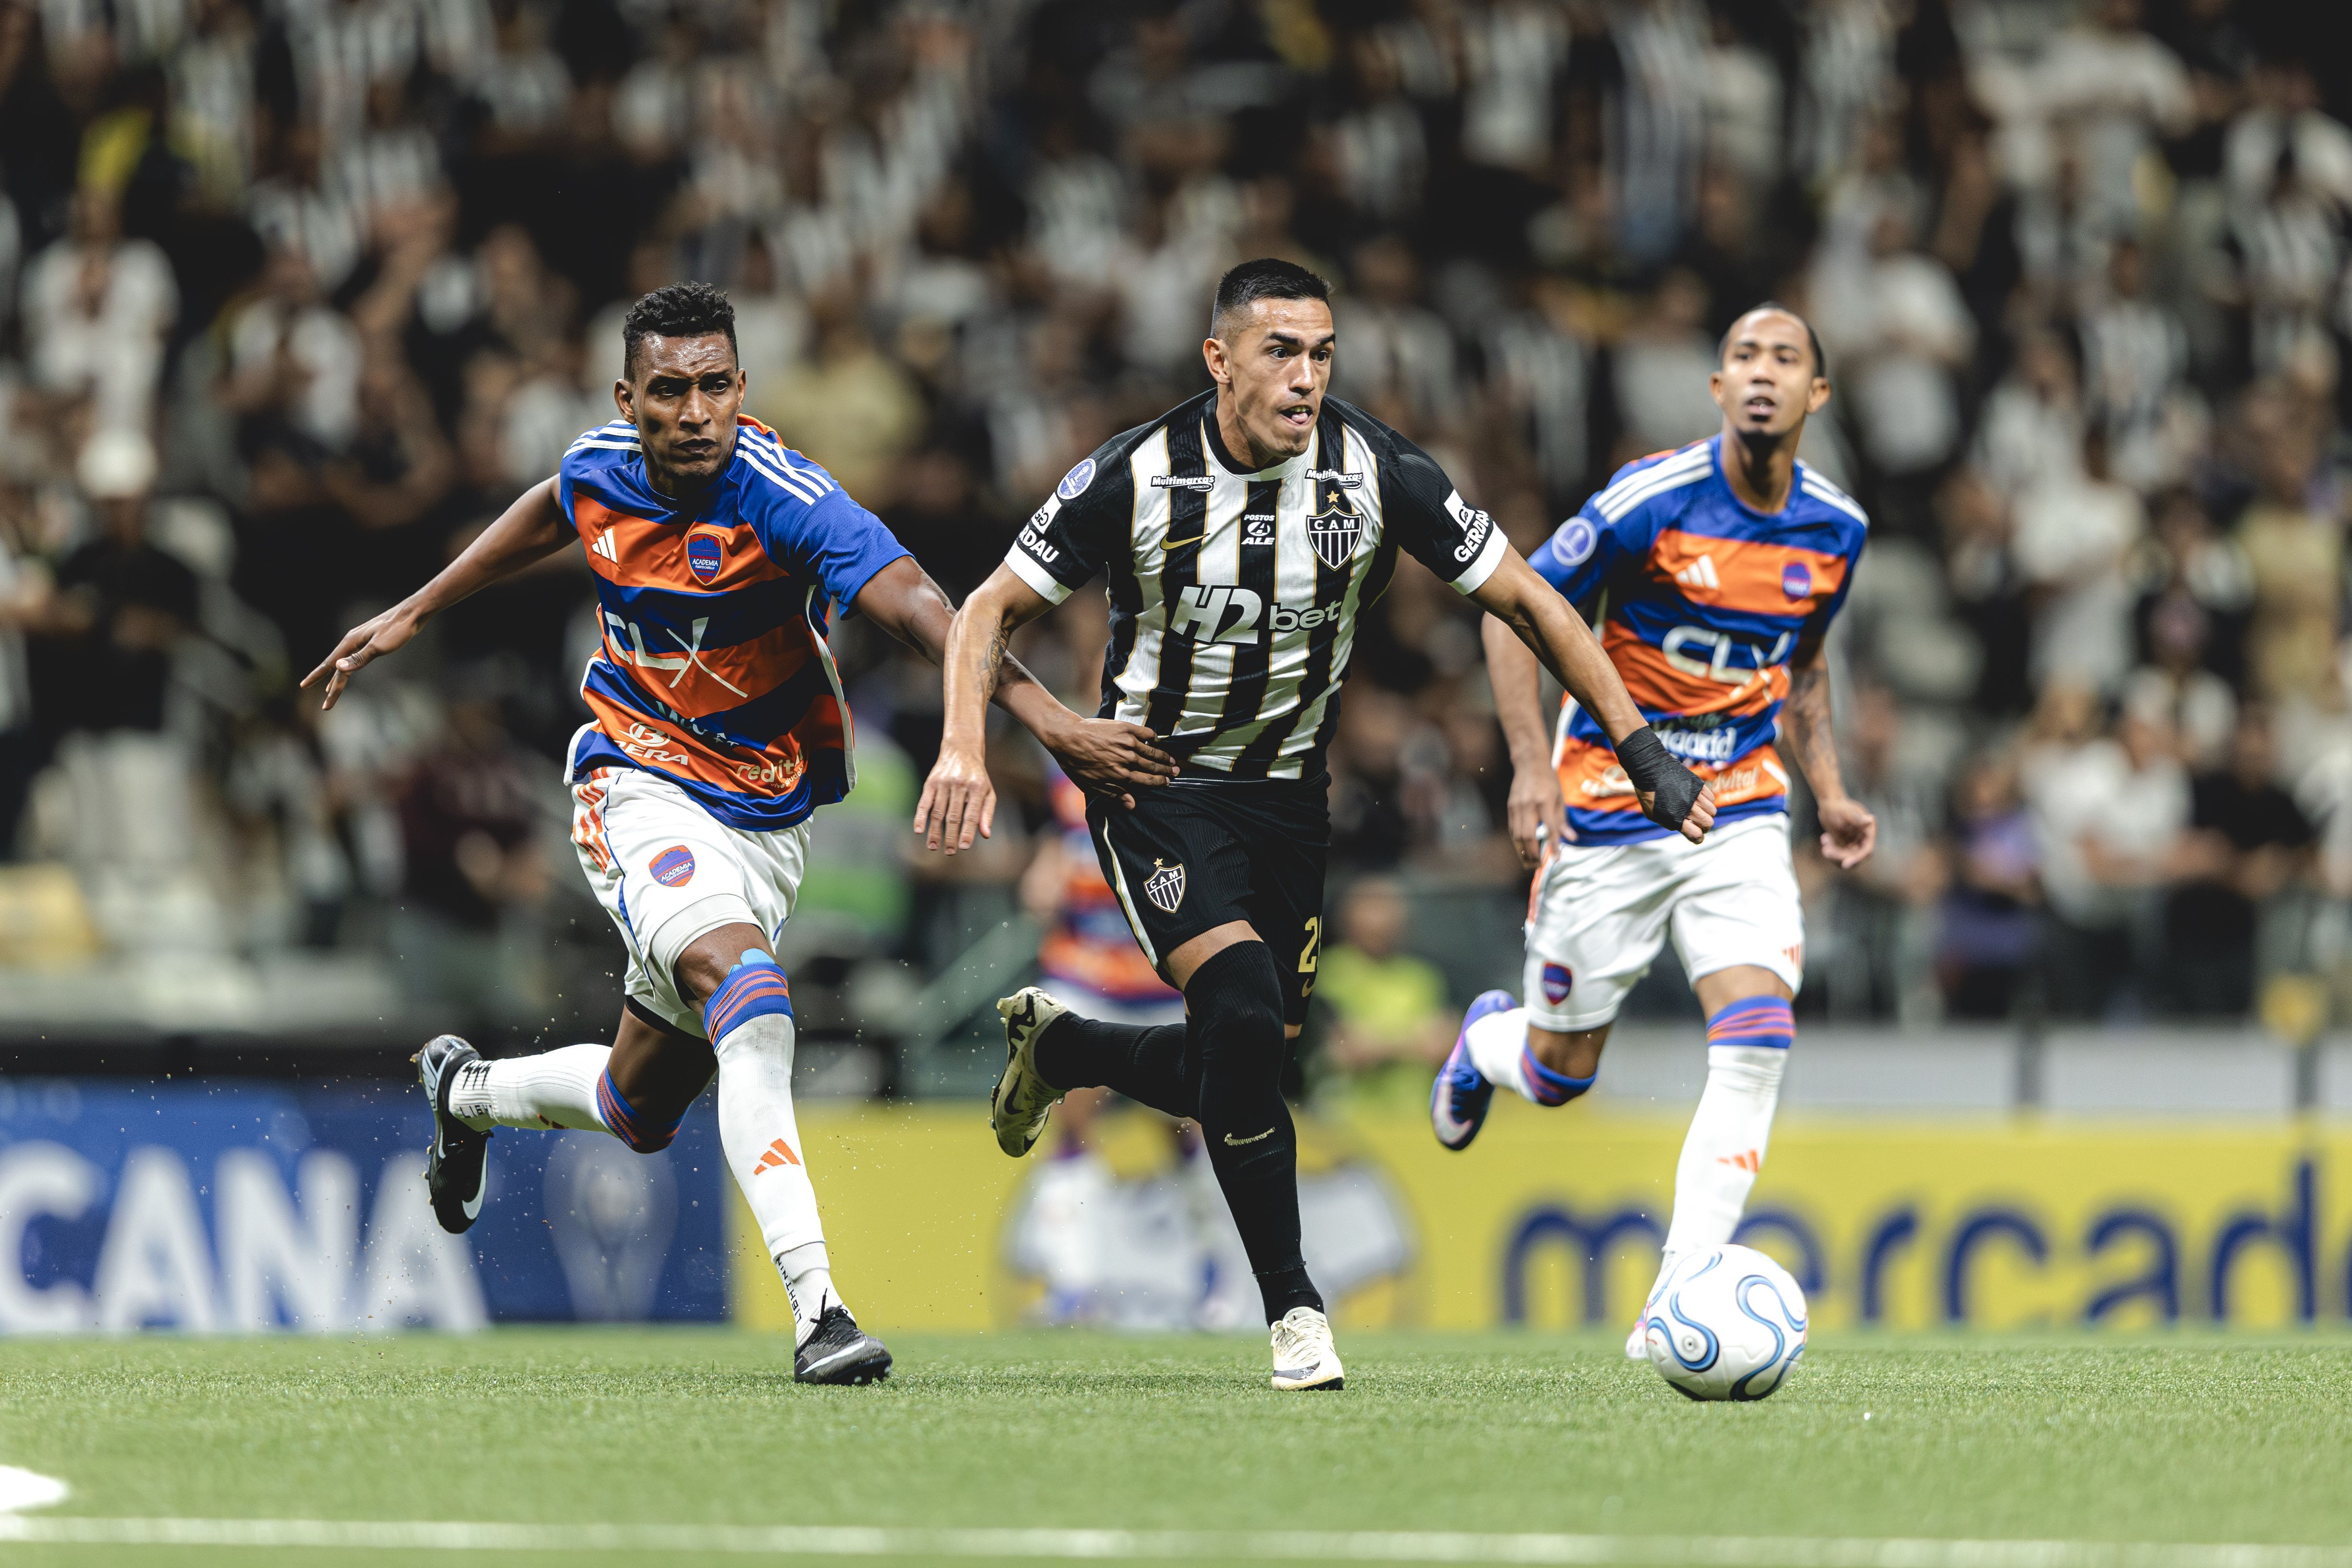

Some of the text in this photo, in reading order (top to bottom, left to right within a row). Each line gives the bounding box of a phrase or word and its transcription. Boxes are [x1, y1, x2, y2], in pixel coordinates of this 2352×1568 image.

[1152, 476, 1215, 485] Multimarcas
[1314, 519, 1355, 530] CAM
[1241, 537, 1275, 545] ALE
[605, 611, 748, 698] CLX
[661, 862, 692, 882] ACADEMIA
[1150, 870, 1178, 889] CAM
[1298, 916, 1318, 973] 2
[0, 1142, 493, 1333] CANA
[1498, 1156, 2352, 1328] mercad
